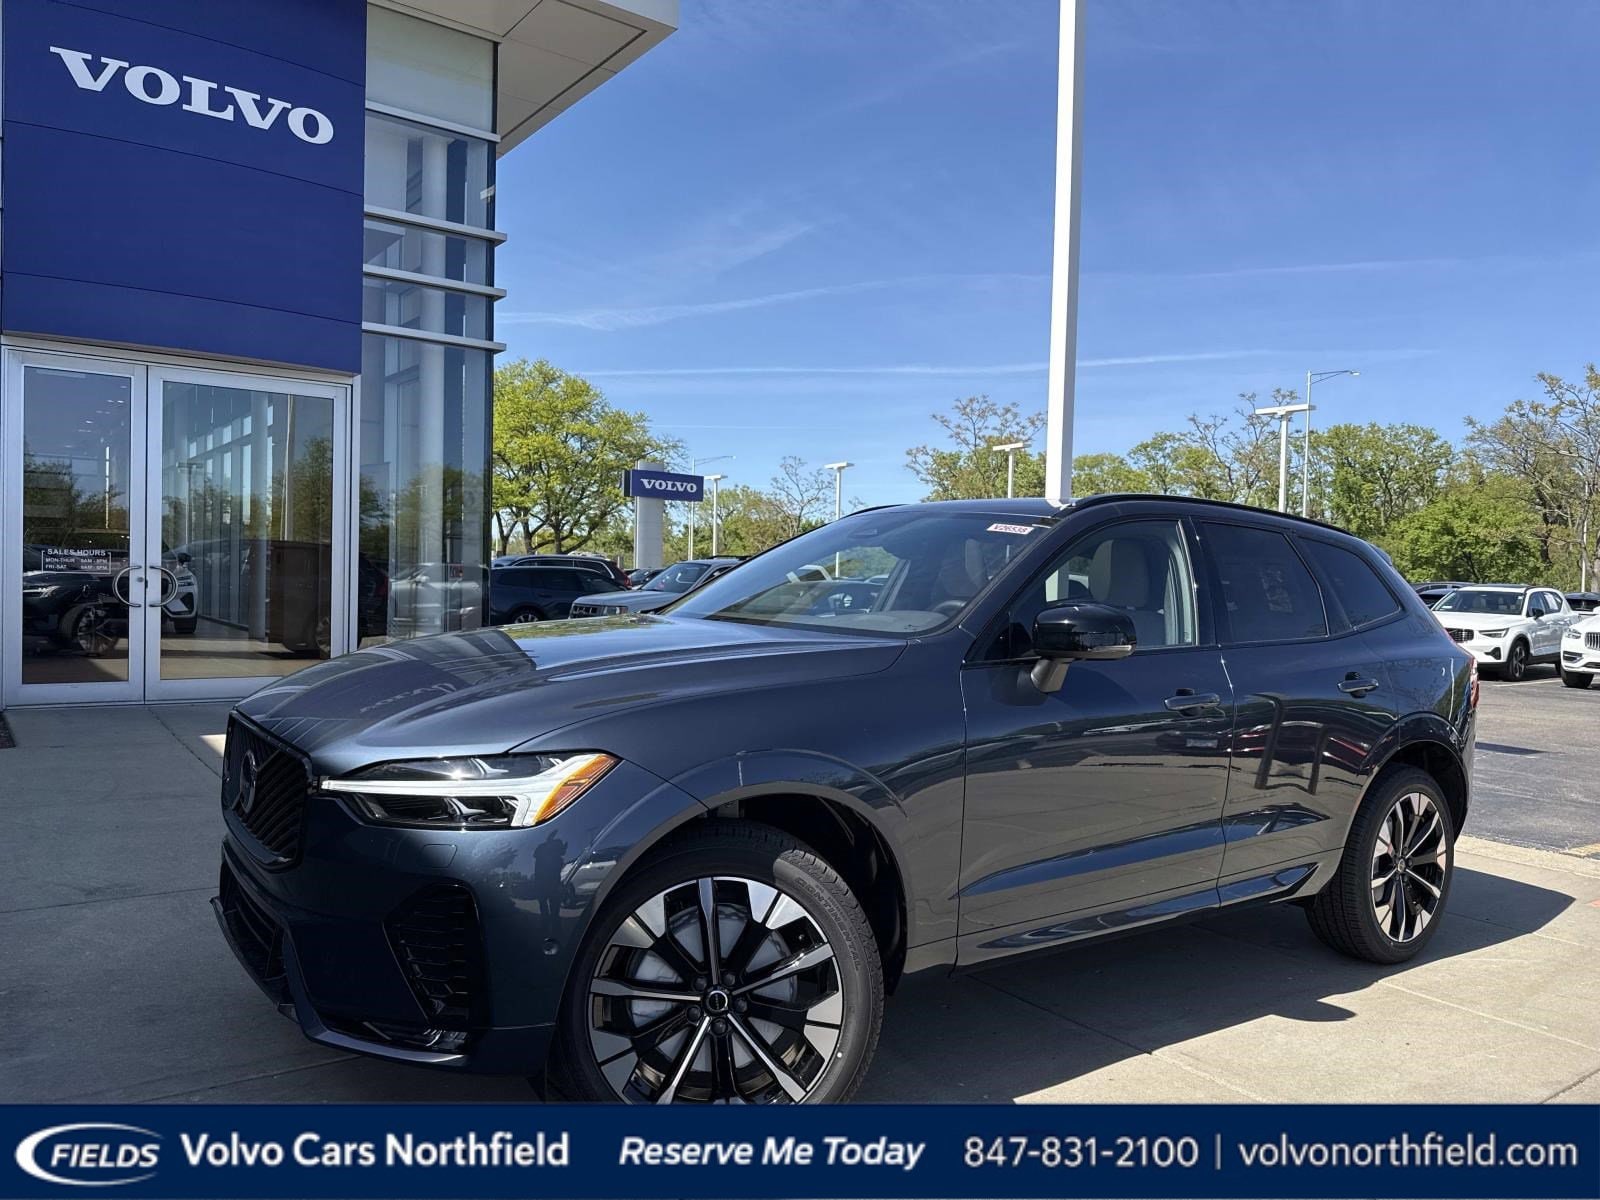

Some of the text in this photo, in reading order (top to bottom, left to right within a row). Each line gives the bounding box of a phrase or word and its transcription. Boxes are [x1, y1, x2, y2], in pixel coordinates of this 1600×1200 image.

[49, 46, 334, 145] VOLVO
[640, 478, 697, 493] VOLVO
[794, 877, 861, 971] CONTINENTAL
